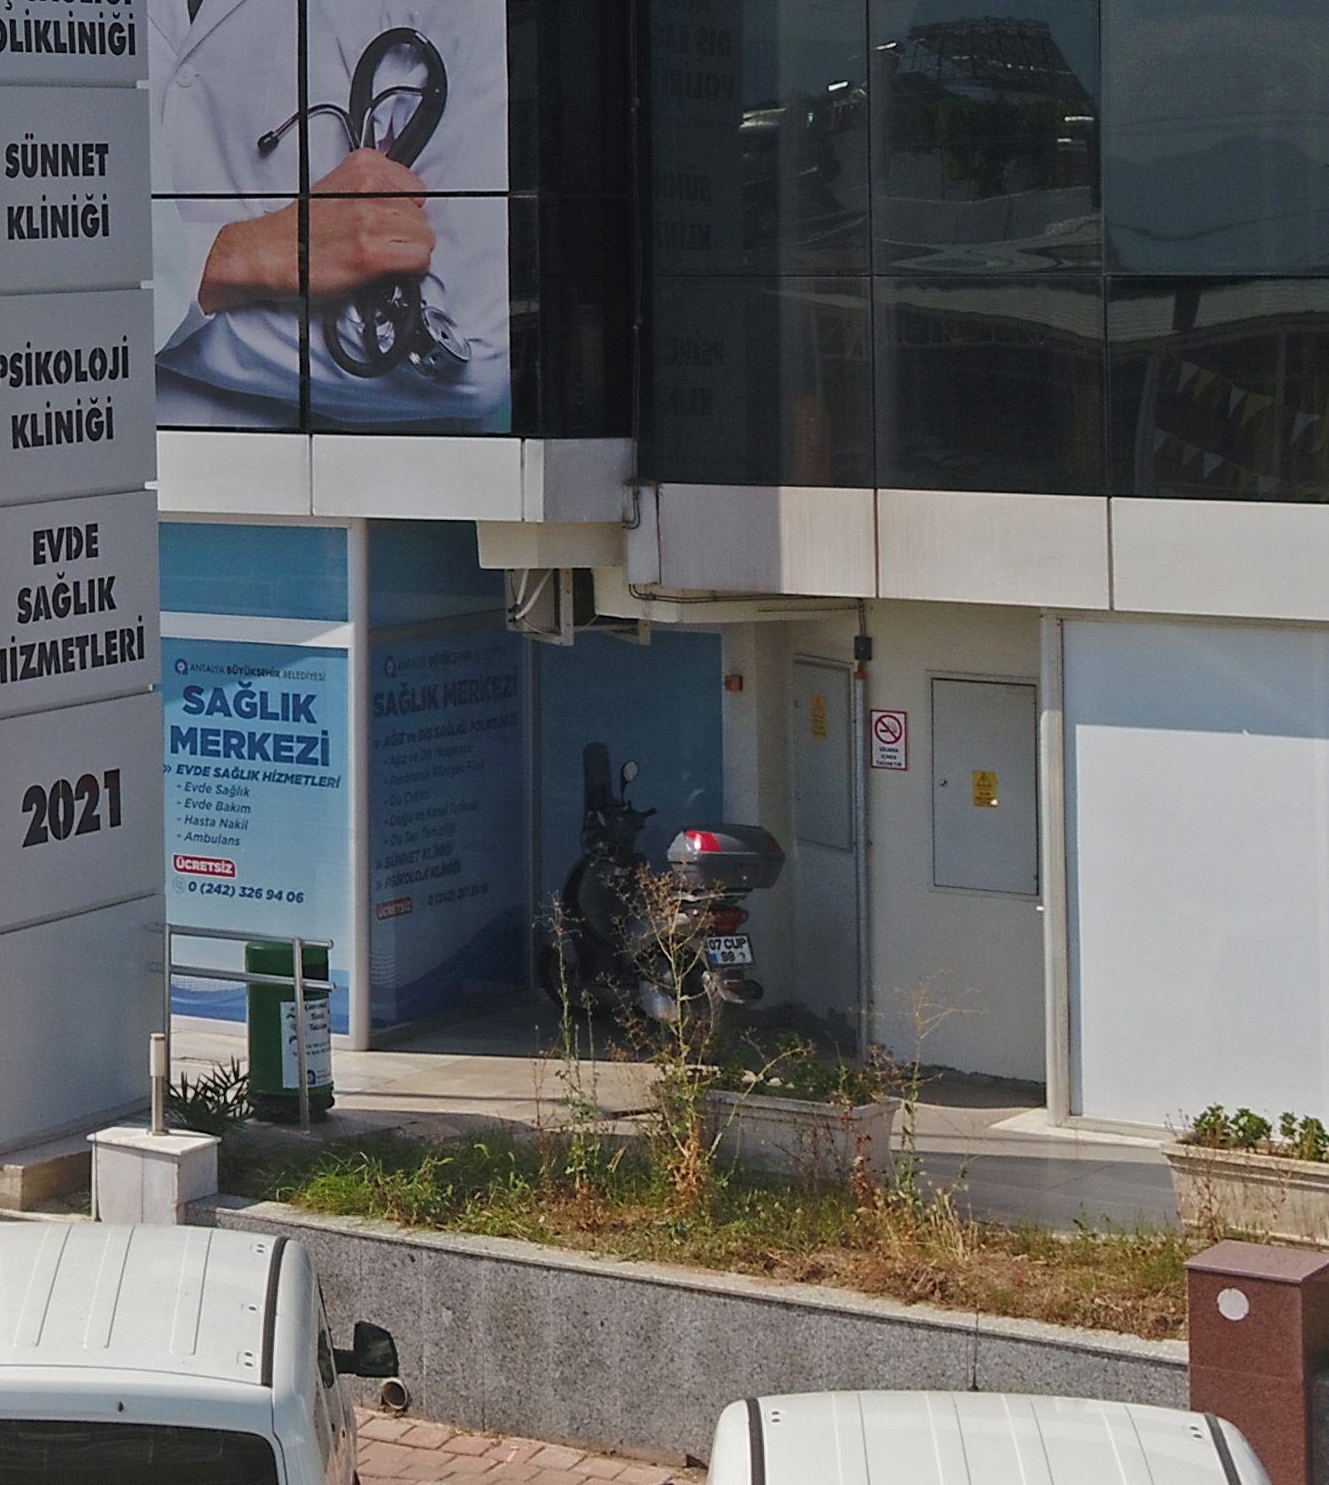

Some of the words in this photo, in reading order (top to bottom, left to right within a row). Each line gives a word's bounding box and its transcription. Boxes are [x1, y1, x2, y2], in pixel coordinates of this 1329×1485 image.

[4, 132, 109, 179] SÜNNET
[6, 193, 110, 240] KLİNİĞİ
[11, 396, 114, 449] KLİNİĞİ
[32, 522, 99, 566] EVDE
[17, 571, 117, 624] SAĞLIK
[190, 664, 225, 674] ANTALYA
[226, 665, 281, 679] BÜYÜKŞEHİR
[283, 668, 326, 681] BELEDİYESİ
[182, 681, 317, 724] SAĞLIK
[373, 682, 439, 719] SAĞLIK
[170, 725, 330, 767] MERKEZİ
[176, 764, 211, 777] EVDE
[213, 765, 260, 782] SAĞLIK
[262, 769, 341, 789] HİZMETLERİ
[184, 782, 213, 795] Evde
[215, 783, 251, 798] Sağlık
[21, 768, 122, 848] 2021
[184, 798, 213, 811] Evde
[215, 800, 251, 814] Bakım
[184, 815, 217, 828] Hasta
[219, 816, 249, 831] Nakil
[184, 831, 241, 847] Ambulans
[176, 856, 233, 875] ÜCRETSİZ
[187, 881, 197, 893] 0
[200, 882, 236, 898] (242)
[238, 886, 263, 899] 326
[265, 888, 283, 901] 94
[286, 890, 304, 903] 06
